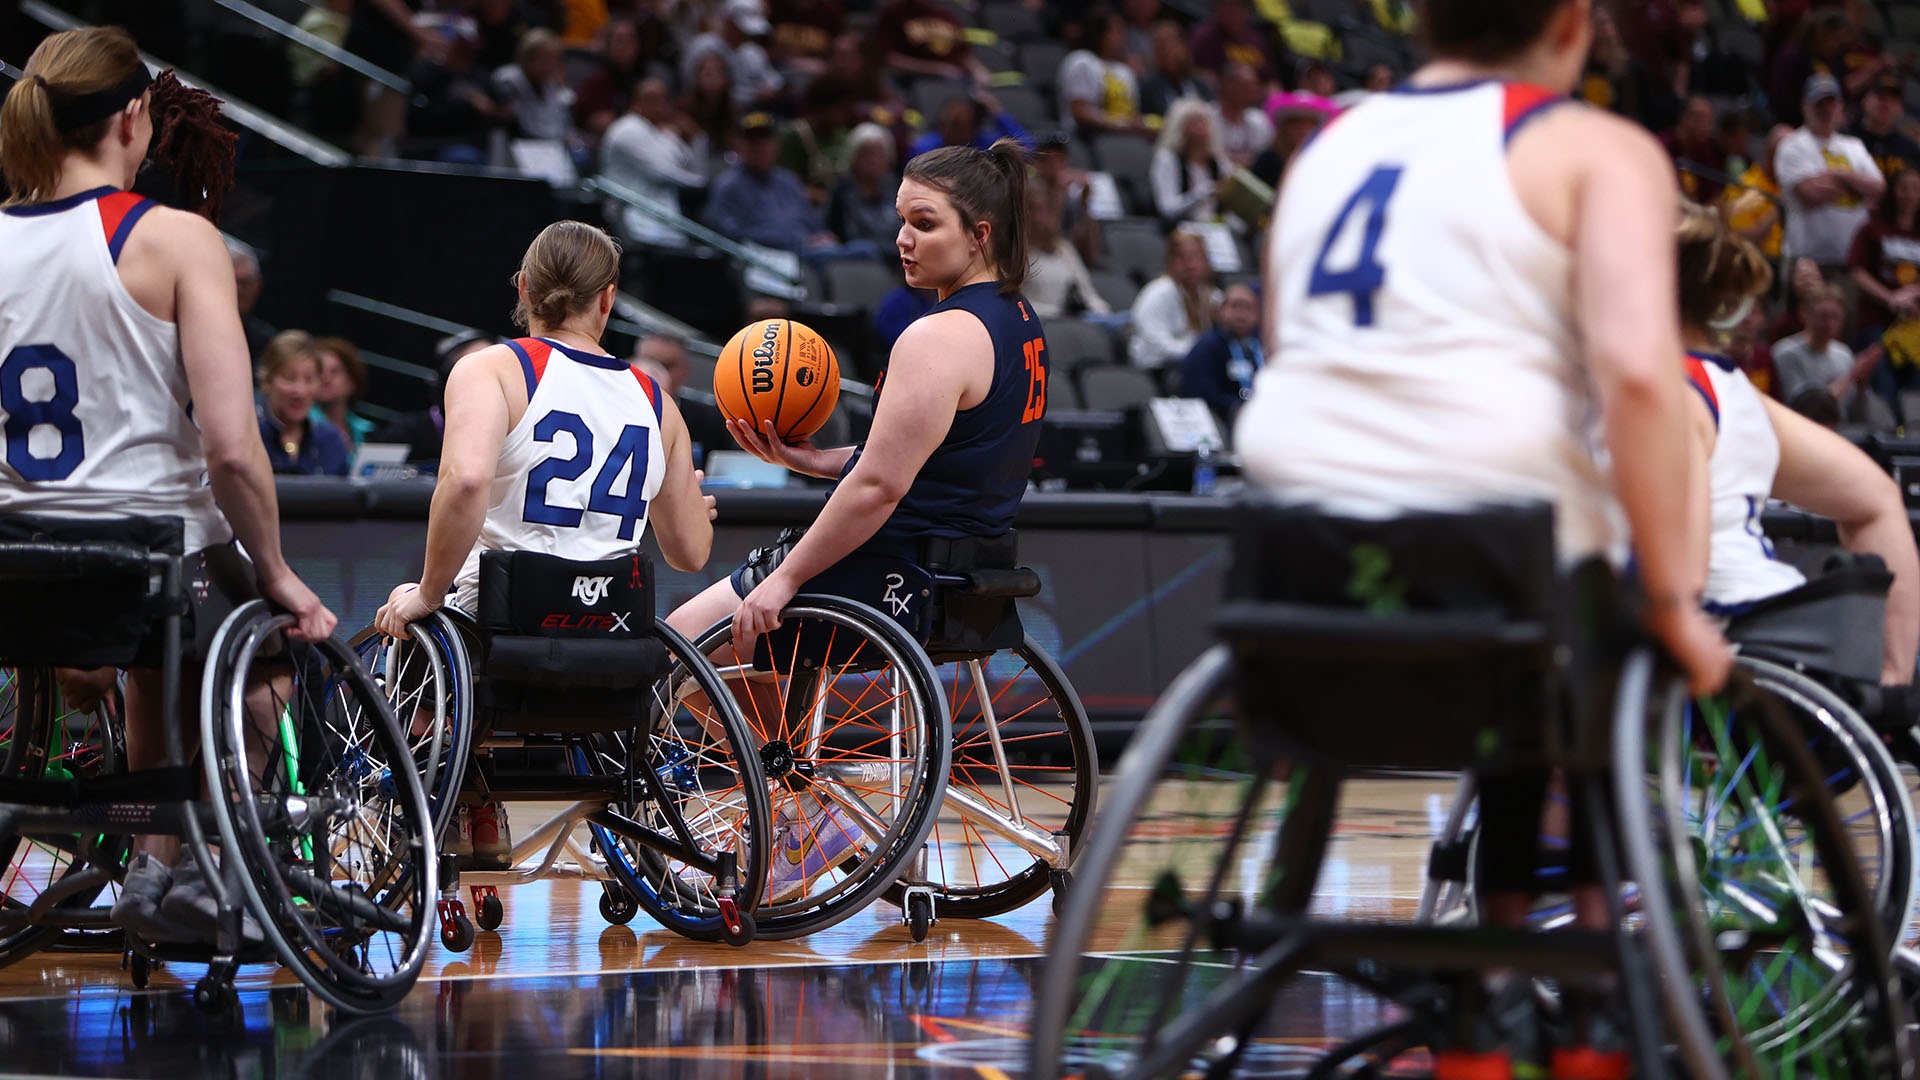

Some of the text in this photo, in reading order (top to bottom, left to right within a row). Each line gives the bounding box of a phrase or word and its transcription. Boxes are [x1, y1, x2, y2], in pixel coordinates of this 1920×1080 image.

[1307, 167, 1402, 328] 4
[0, 343, 85, 482] 8
[752, 323, 781, 395] Wilson
[1021, 337, 1045, 424] 25
[522, 409, 650, 541] 24
